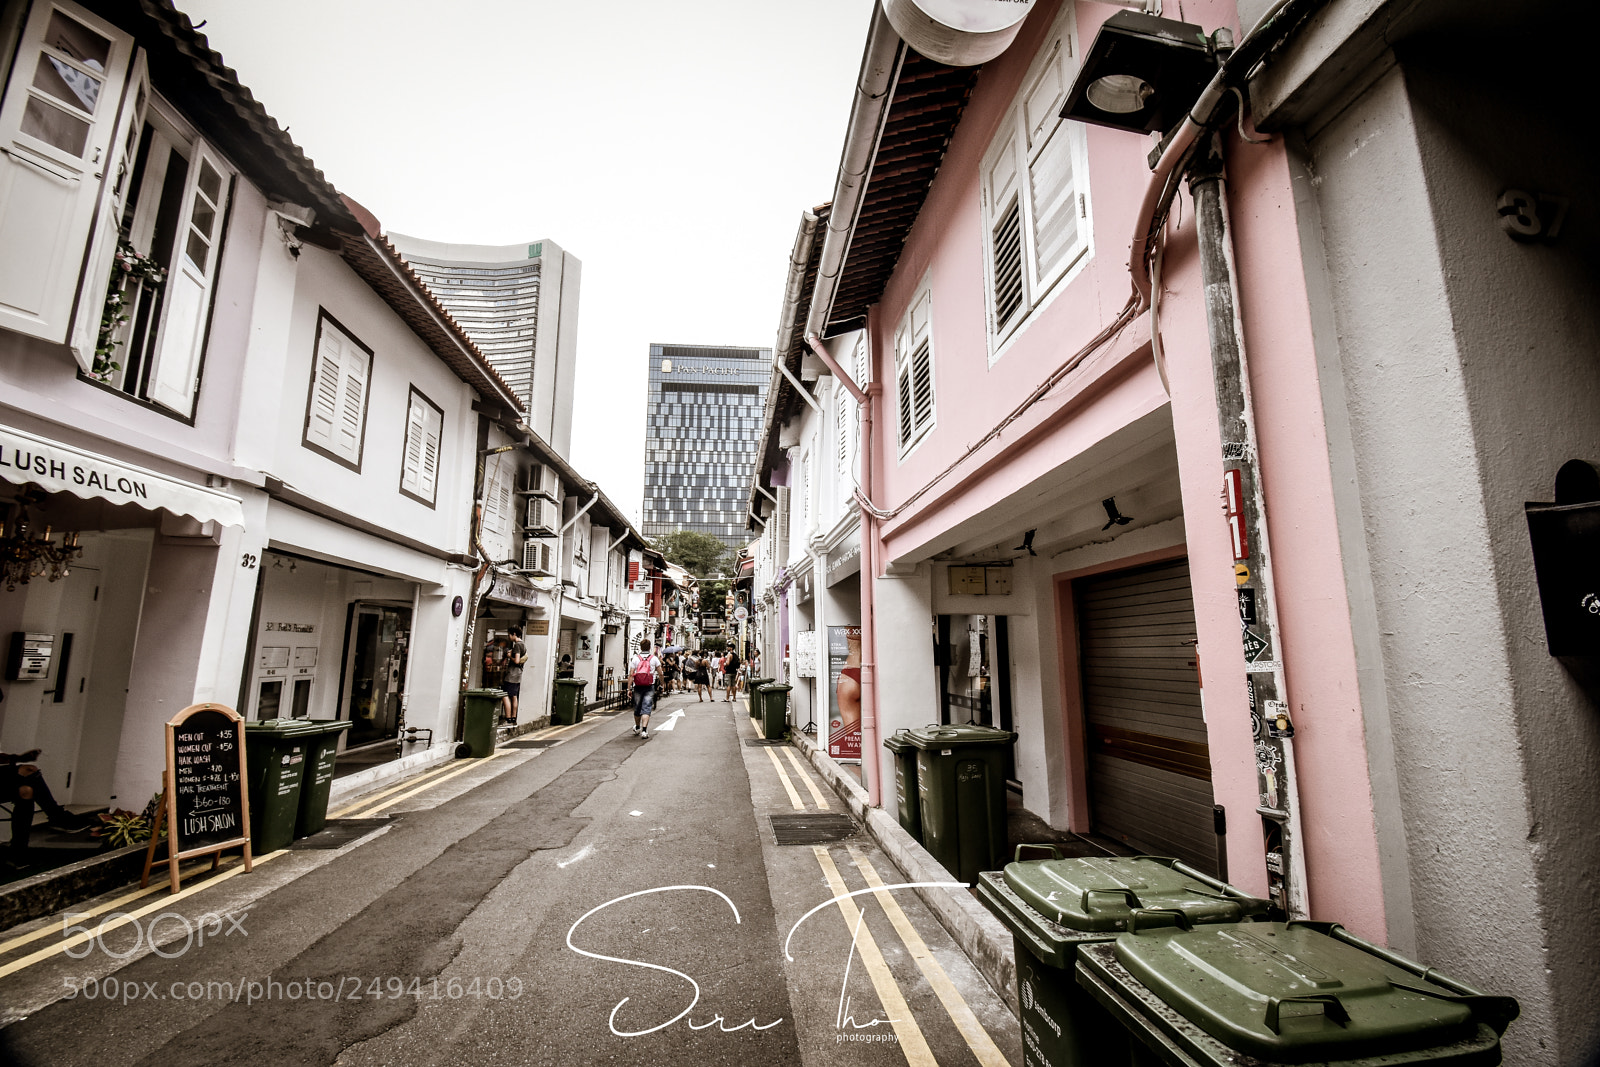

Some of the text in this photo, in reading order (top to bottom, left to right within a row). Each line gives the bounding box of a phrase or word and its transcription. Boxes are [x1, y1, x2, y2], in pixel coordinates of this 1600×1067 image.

[1497, 188, 1570, 238] 37
[702, 365, 741, 376] PACIFIC
[0, 445, 148, 498] LUSH SALON
[241, 553, 256, 570] 32
[178, 734, 192, 742] MEN
[194, 732, 204, 741] CUT
[178, 744, 200, 754] WOMEN
[201, 743, 212, 752] CUT
[194, 755, 211, 764] WASH
[180, 783, 229, 794] HAIR TREATMENT
[184, 813, 235, 836] LUSH SALON
[1034, 1000, 1062, 1038] sembcorp
